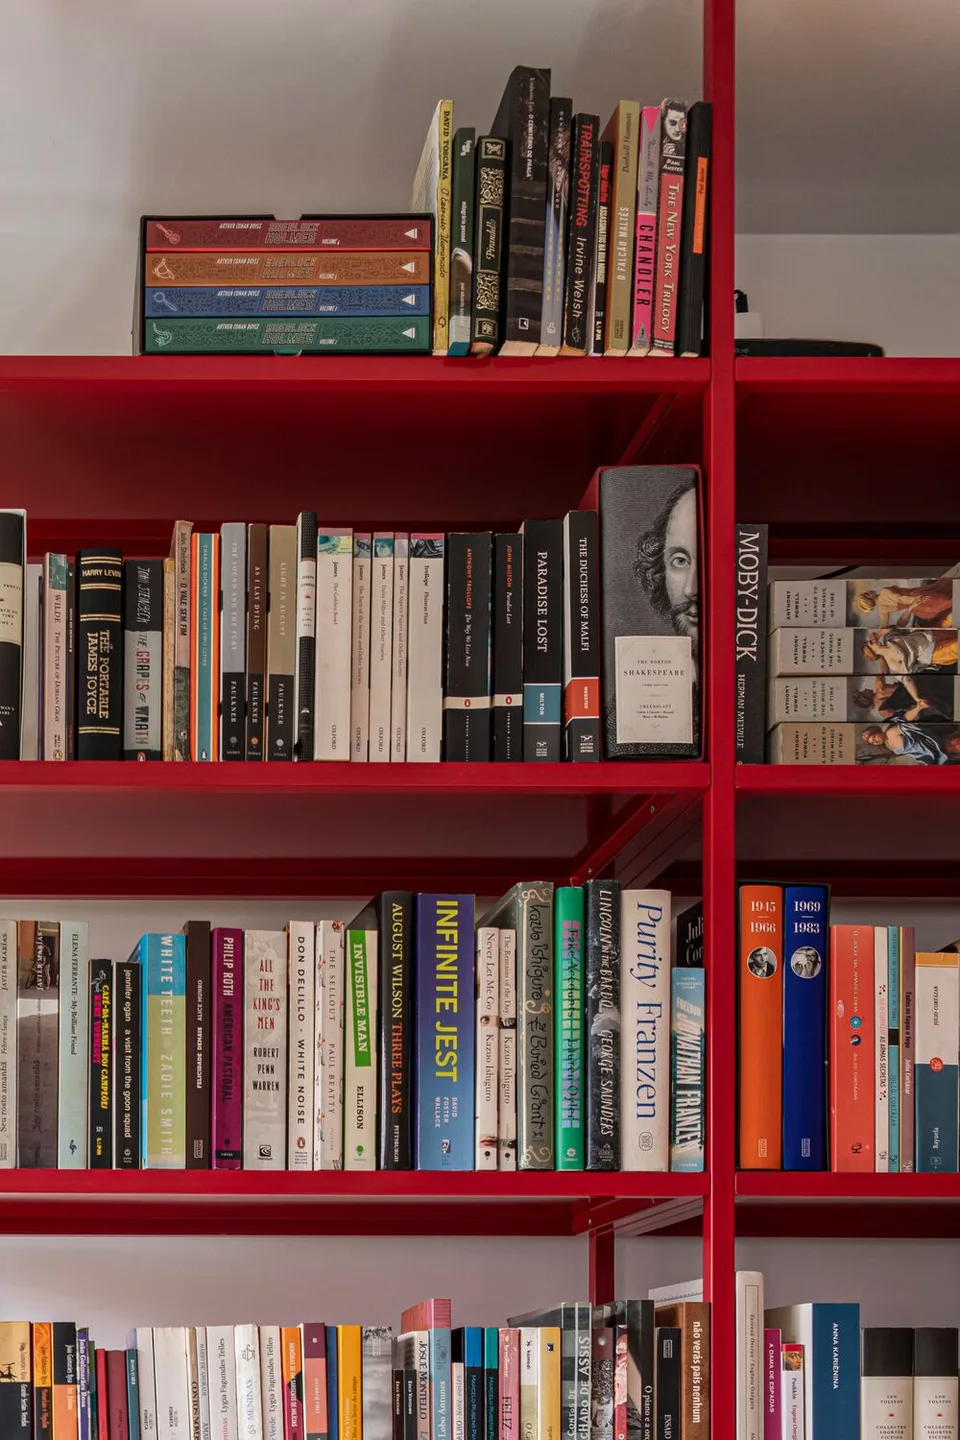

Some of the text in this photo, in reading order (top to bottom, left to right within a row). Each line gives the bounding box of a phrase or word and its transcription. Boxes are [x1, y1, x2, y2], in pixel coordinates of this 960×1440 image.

[441, 111, 450, 180] DAVID TOSCANA
[572, 123, 593, 318] TRAINSPOTTING Irvine Welsh
[636, 224, 653, 307] CHANDLER
[661, 183, 680, 333] THE NEW YORK TRILOGY
[262, 332, 313, 344] HOLMES
[579, 537, 588, 558] THE
[82, 569, 102, 577] HARRY
[254, 566, 261, 577] AS
[579, 560, 589, 604] DUCHESS
[136, 566, 150, 624] JOHN STEINBECK
[536, 551, 548, 652] PARADISE LOST
[98, 630, 110, 653] THE
[138, 634, 148, 647] THE
[580, 622, 589, 651] MALFI
[736, 531, 759, 749] MOBY-DICK HERMAN MELVILLE
[86, 632, 98, 715] JAMES JOYCE
[136, 650, 151, 691] GRAPES
[623, 668, 686, 678] SHAKESPEARE
[135, 706, 150, 745] WRATH
[599, 890, 612, 943] LINCOLN
[750, 901, 776, 912] 1945
[793, 901, 820, 912] 1969
[392, 903, 403, 960] AUGUST
[749, 922, 776, 933] 1966
[793, 922, 820, 934] 1983
[259, 960, 274, 972] ALL
[602, 954, 610, 967] THE
[123, 969, 133, 1000] jennifer
[259, 978, 274, 991] THE
[392, 966, 402, 1018] WILSON
[436, 900, 458, 1082] INFINITE JEST
[601, 969, 613, 1008] BARDO
[123, 1002, 131, 1021] egan
[222, 937, 234, 1102] PHILIP ROTH AMERICAN PASTORAL
[252, 997, 281, 1010] KING'S
[484, 933, 495, 1102] Never Let Me Go Kazuo Ishiguro
[629, 902, 663, 1119] Purity Franzen
[257, 1017, 275, 1030] MEN
[297, 936, 305, 1125] DON DELILLO WHITE NOISE
[353, 943, 368, 1129] INVISIBLE MAN ELLISON
[124, 1037, 133, 1053] visit
[160, 935, 172, 1155] WHITE TEETH ZADIE SMITH
[253, 1047, 279, 1058] ROBERT
[392, 1022, 402, 1068] THREE
[599, 1030, 613, 1074] GEORGE
[676, 1015, 701, 1085] JONATHAN
[124, 1055, 133, 1074] from
[258, 1064, 275, 1074] PENN
[124, 1076, 132, 1089] the
[252, 1081, 280, 1091] WARREN
[392, 1072, 402, 1114] PLAYS
[123, 1091, 131, 1111] goon
[601, 1080, 613, 1136] SAUNDERS
[123, 1113, 132, 1138] squad
[675, 1090, 701, 1153] FRANZEN
[219, 1359, 228, 1393] Fagundes
[691, 1321, 703, 1423] não verás país nenhum
[220, 1394, 228, 1413] Lygia
[501, 1396, 512, 1431] FELIZ
